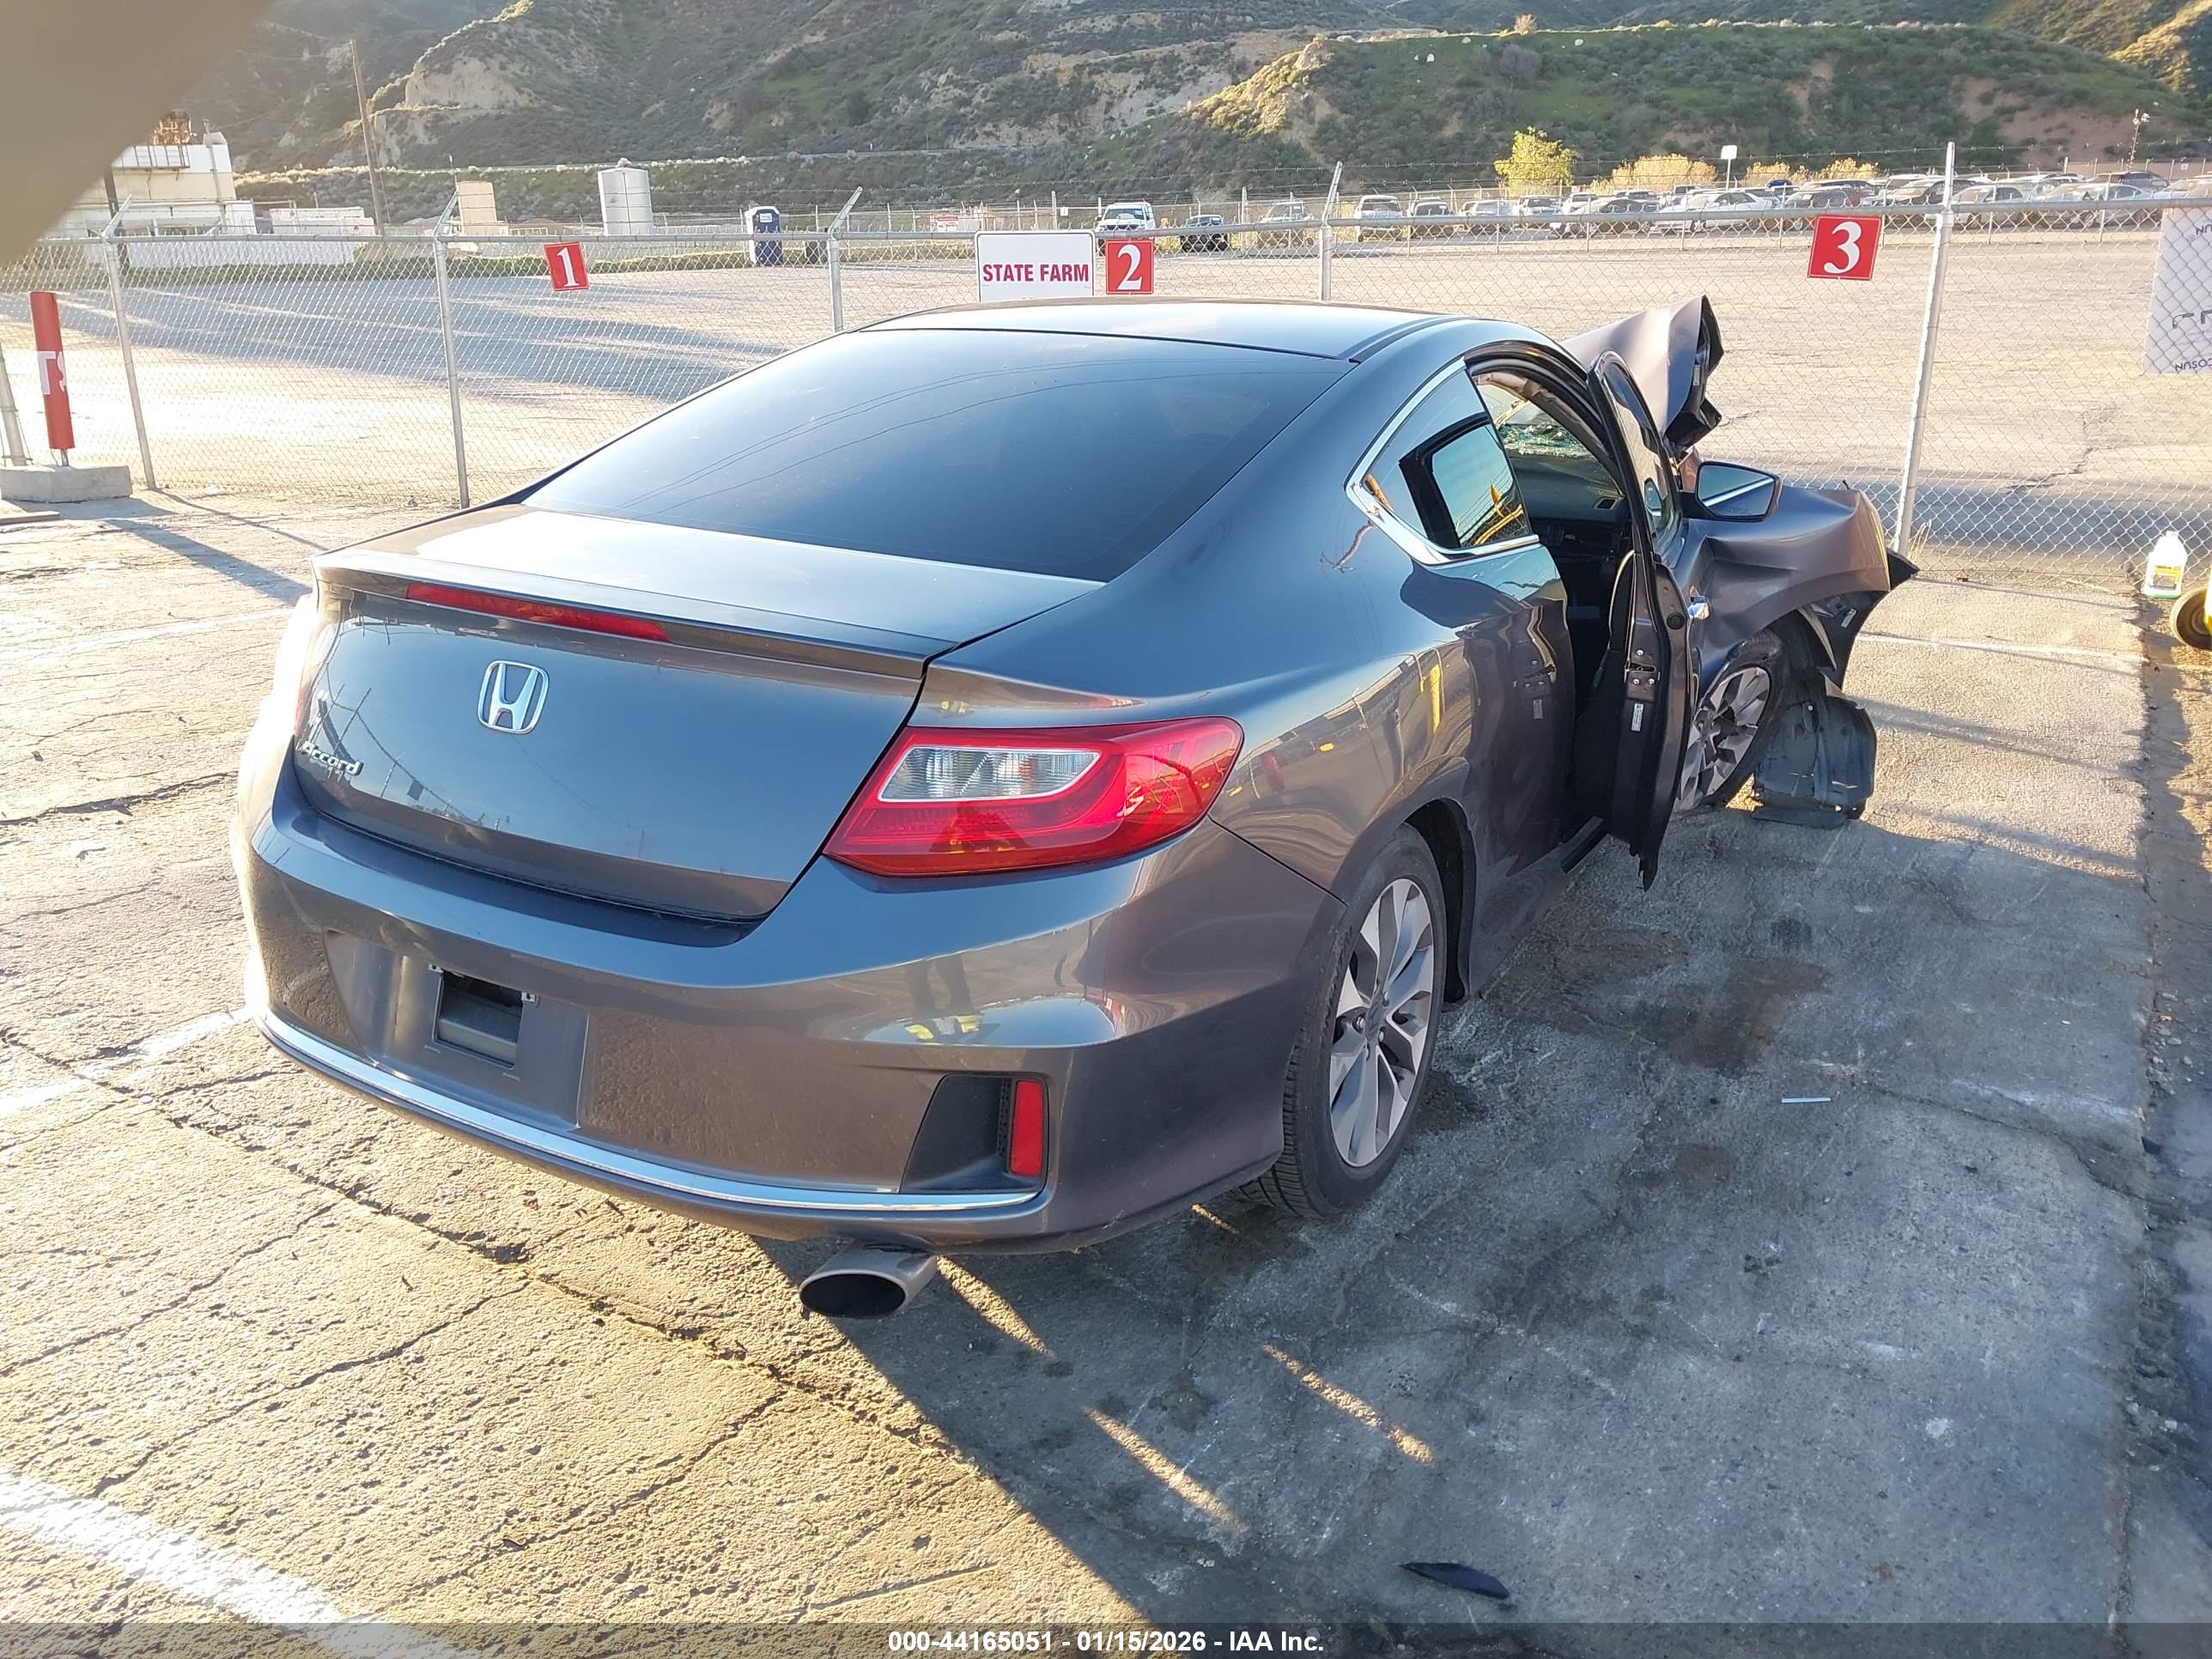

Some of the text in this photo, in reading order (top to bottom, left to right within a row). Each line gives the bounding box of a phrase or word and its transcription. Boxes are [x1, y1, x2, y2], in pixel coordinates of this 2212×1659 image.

[556, 246, 580, 287] 1
[1116, 244, 1143, 290] 2
[1823, 221, 1863, 274] 3
[982, 264, 1090, 282] STATE FARM
[298, 740, 363, 775] Accord
